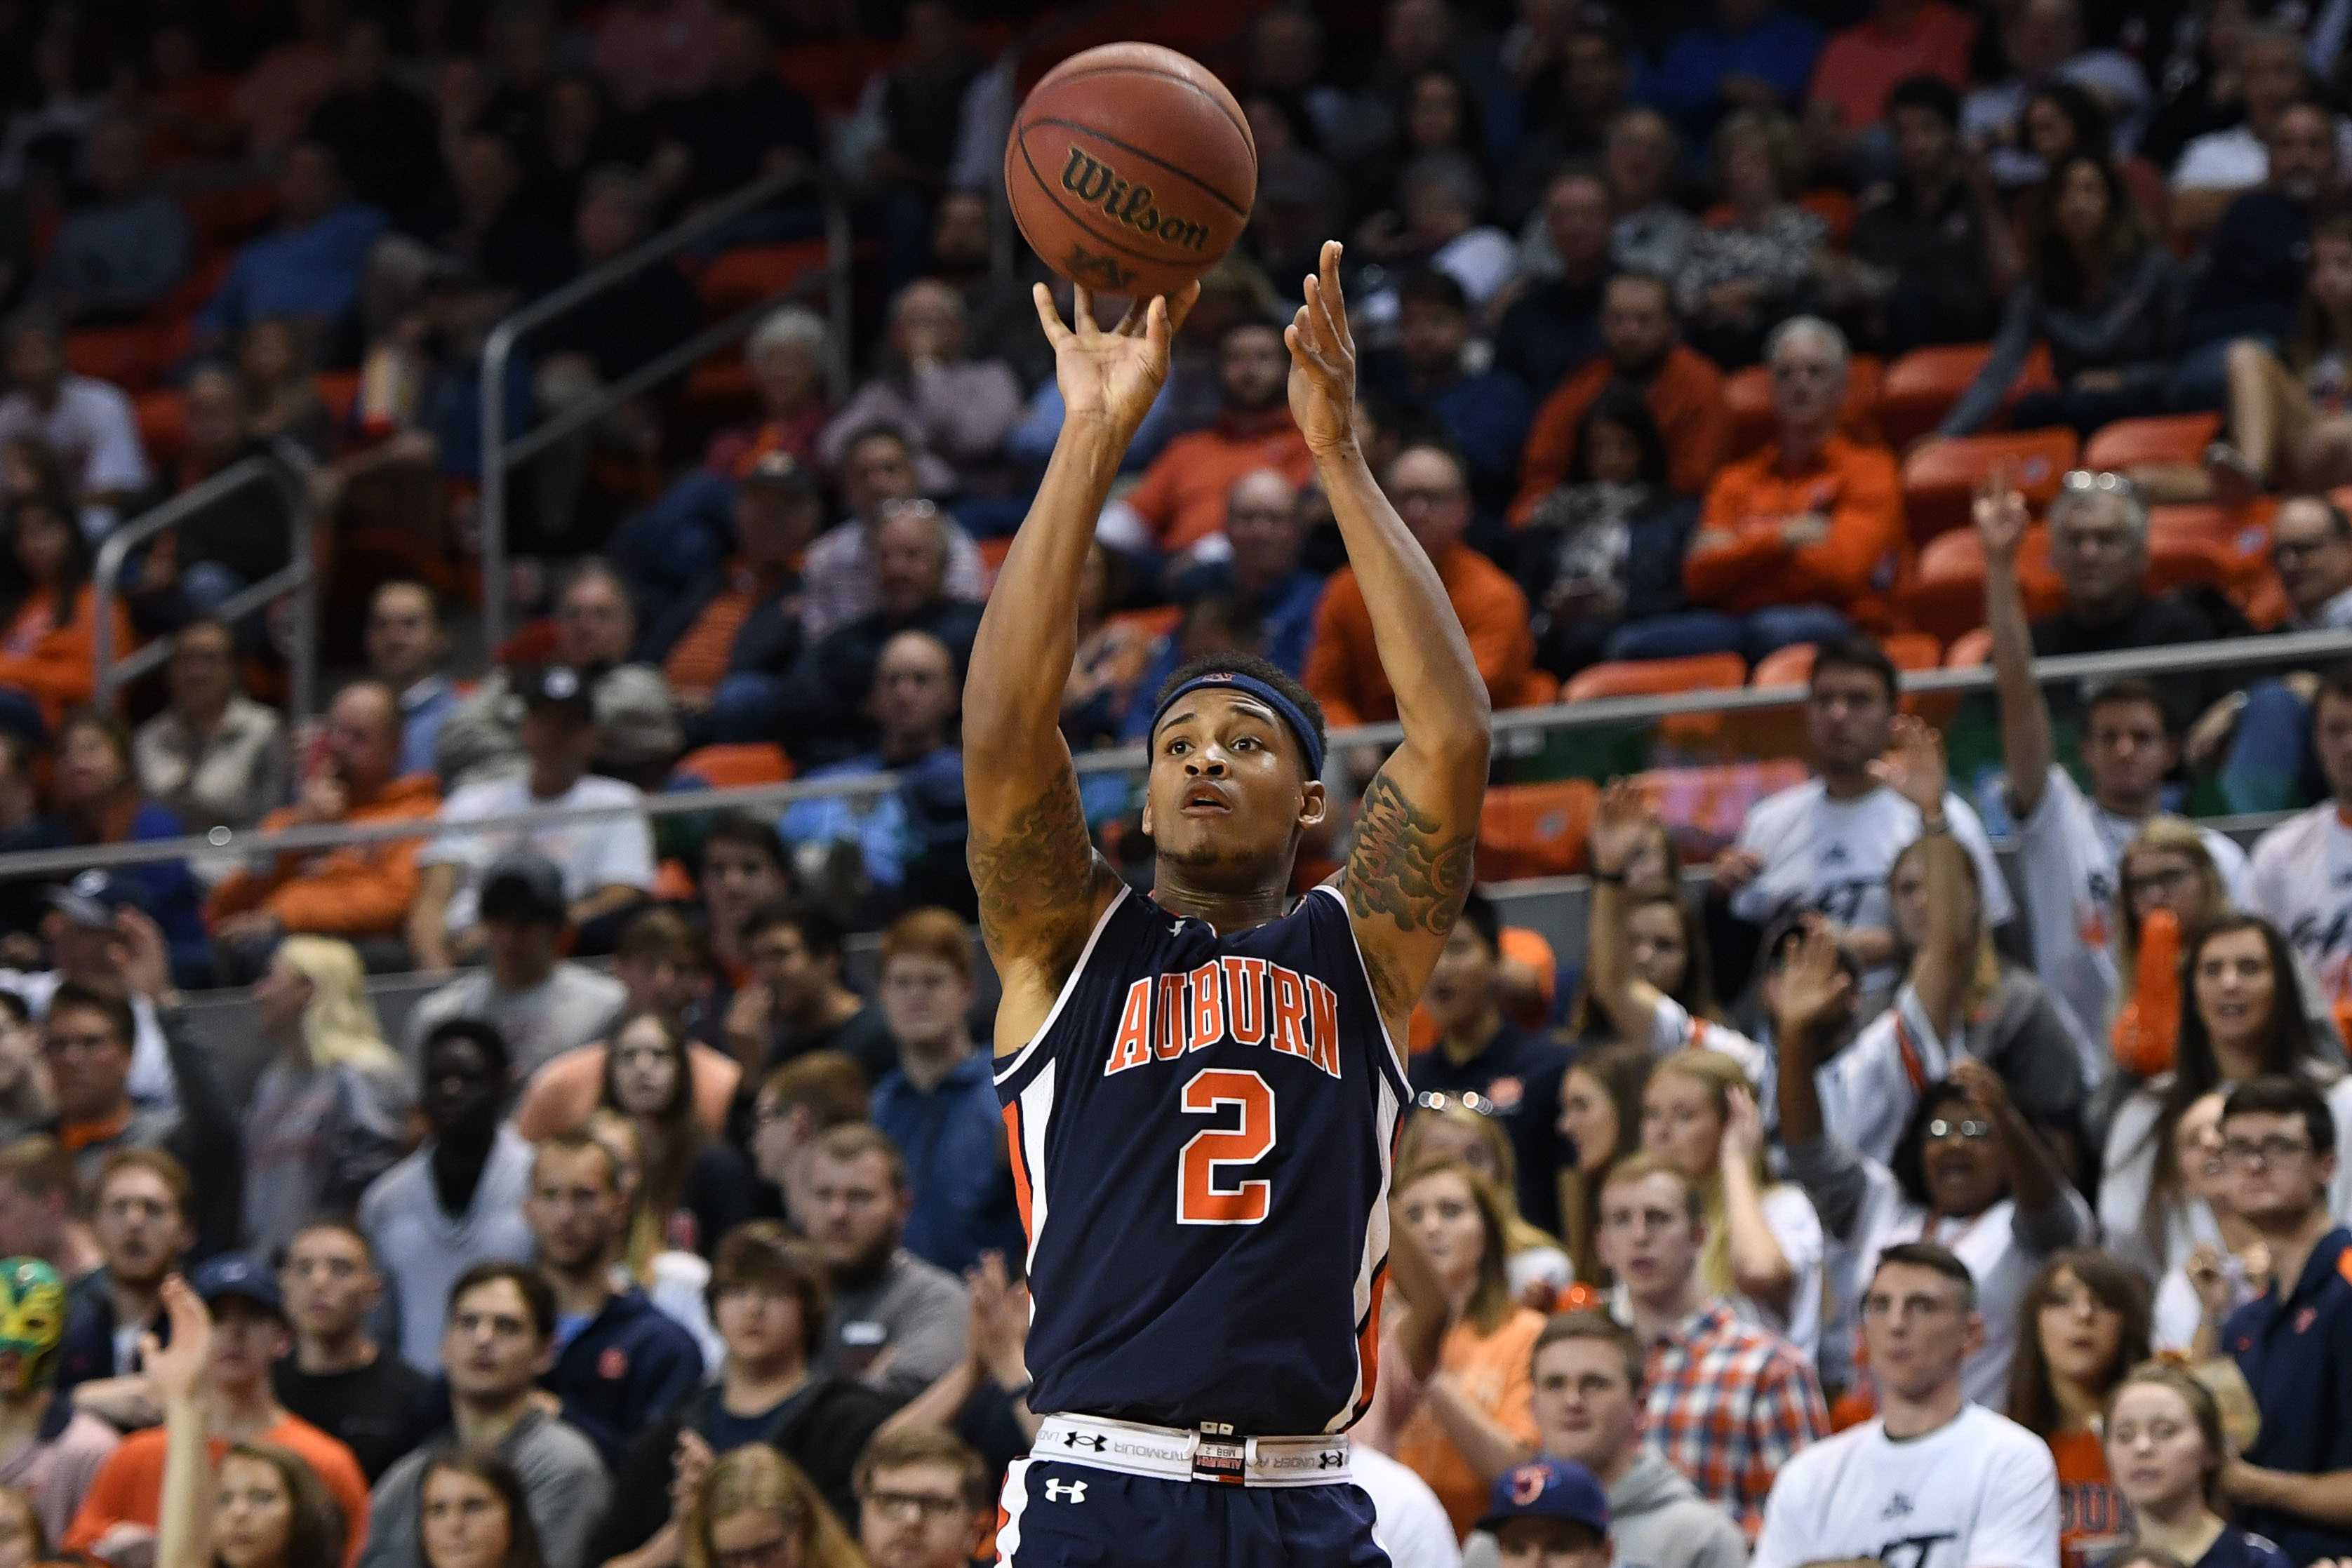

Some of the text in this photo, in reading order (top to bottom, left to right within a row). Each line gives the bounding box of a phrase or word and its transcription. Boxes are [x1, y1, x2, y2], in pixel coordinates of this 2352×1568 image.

[1060, 143, 1211, 253] Wilson
[1104, 955, 1342, 1079] AUBURN
[1177, 1068, 1276, 1225] 2
[1196, 1456, 1242, 1470] AUBURN
[1273, 1457, 1315, 1469] UNDER
